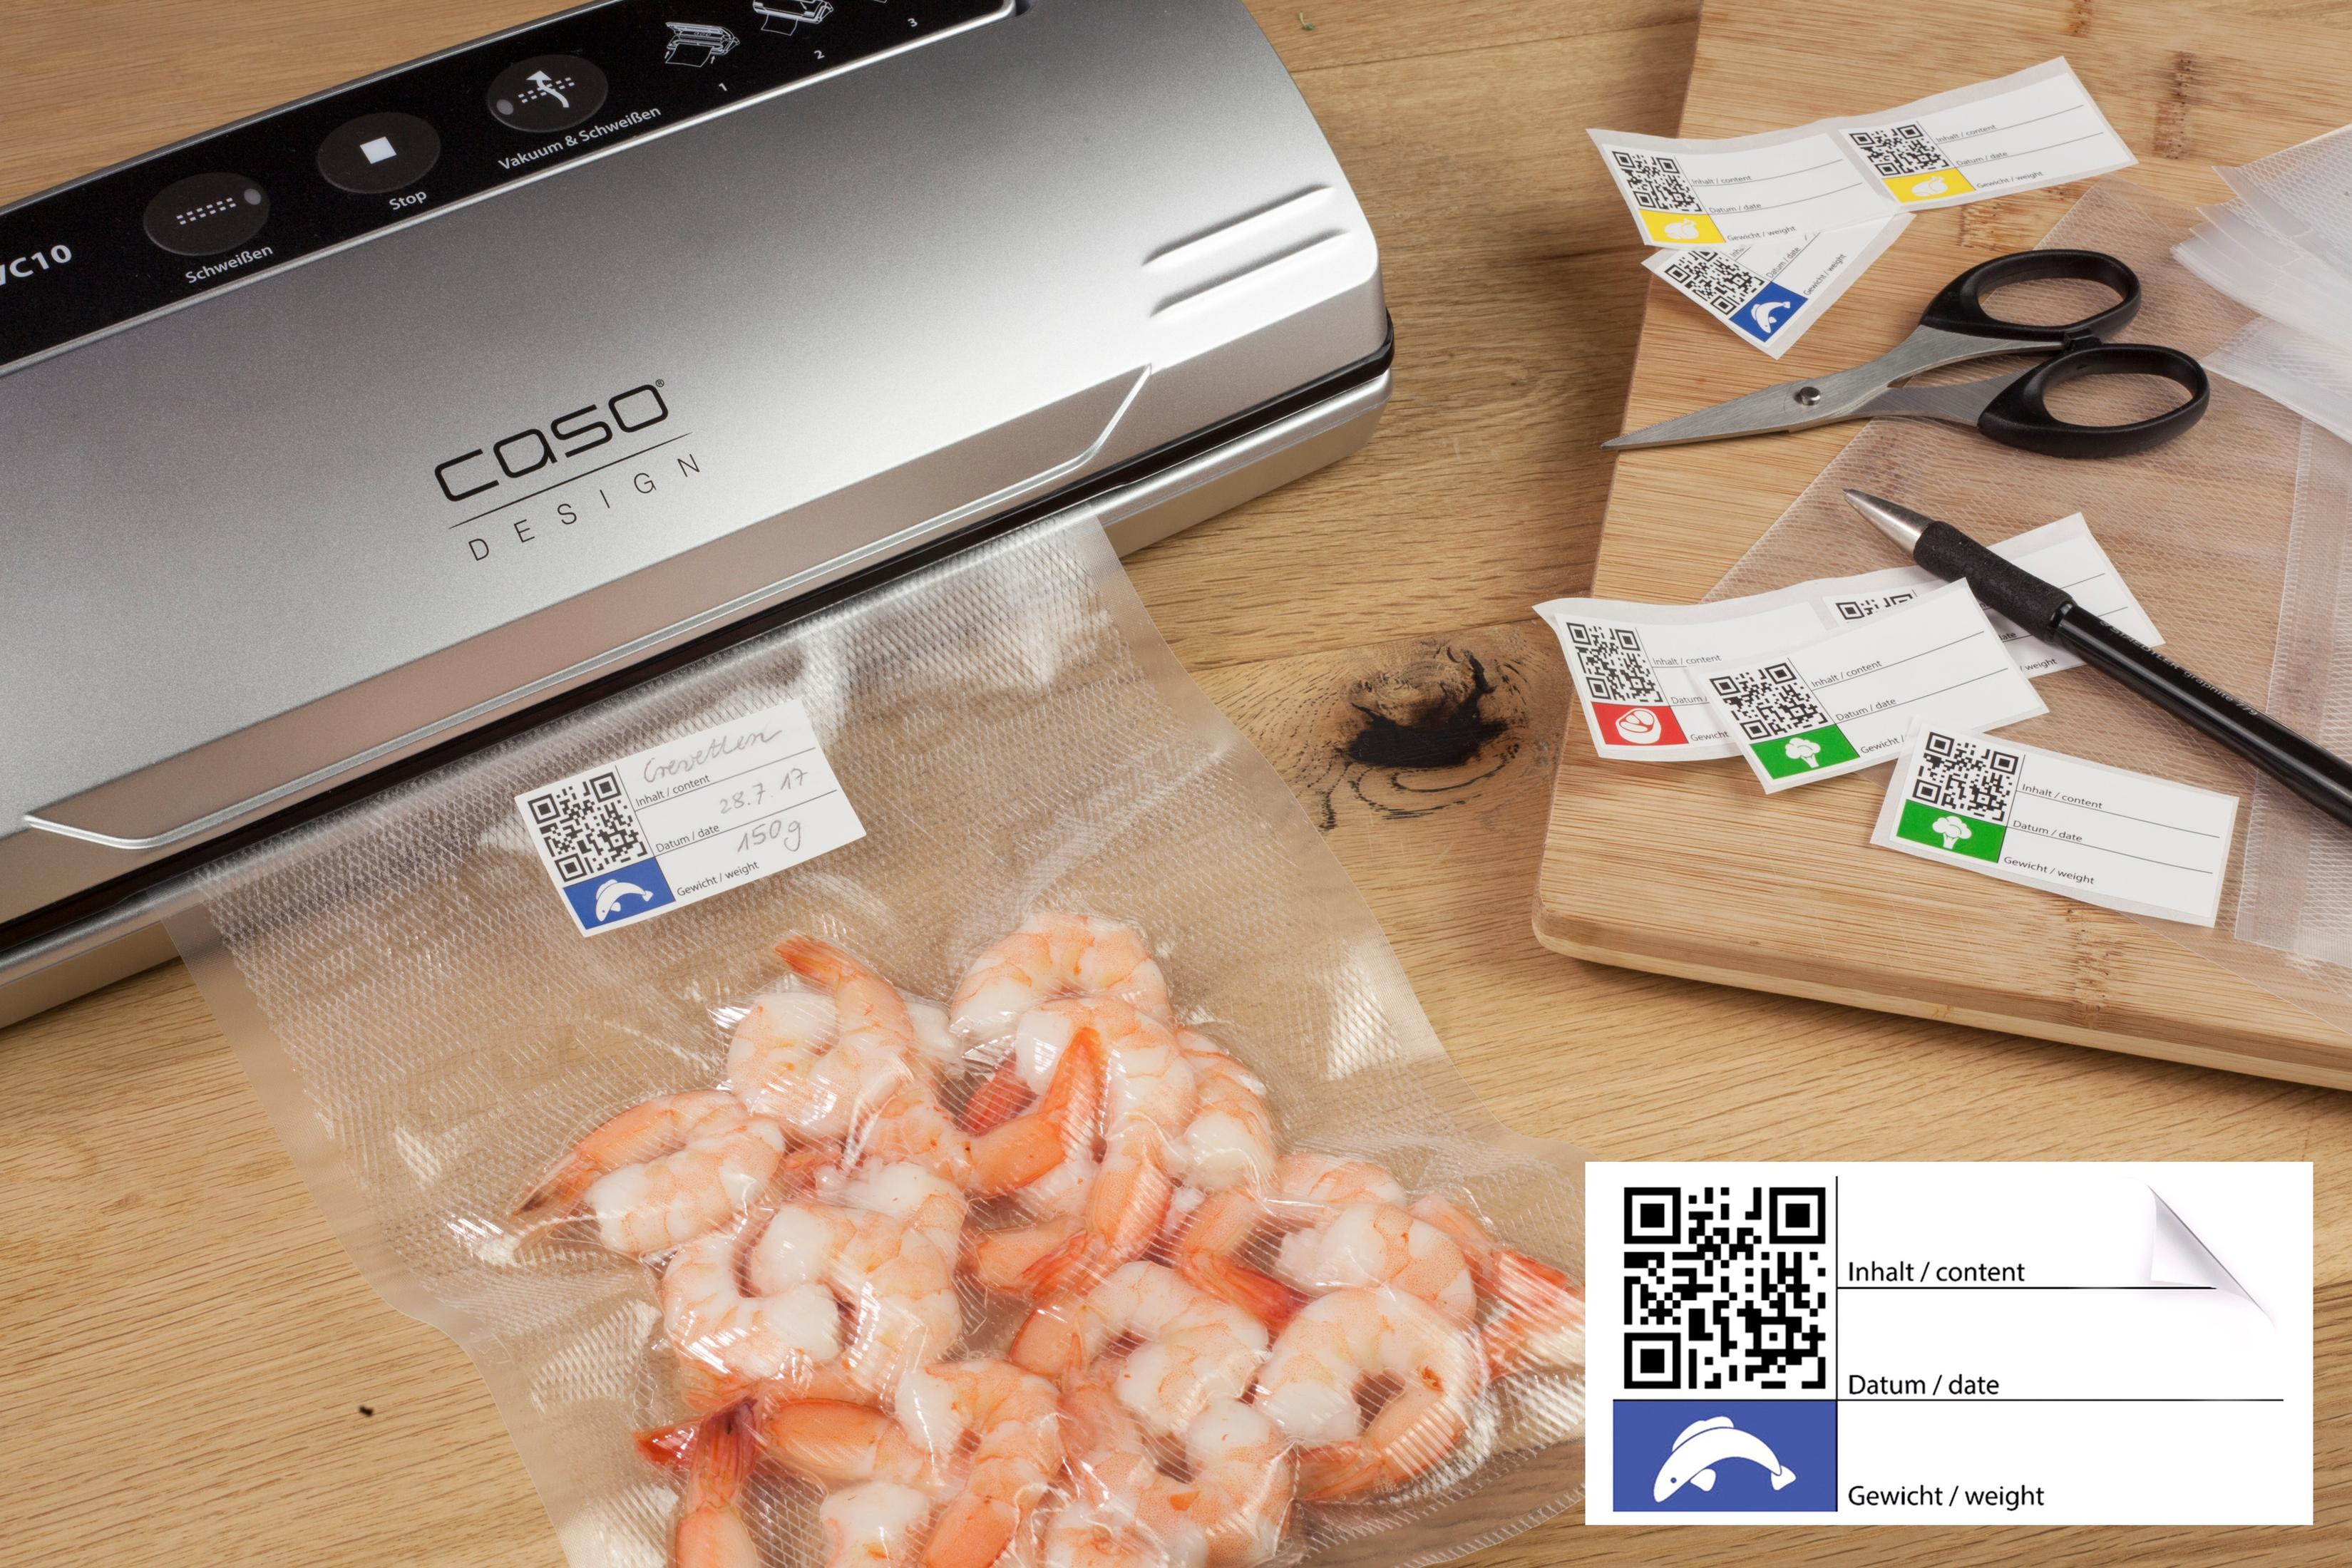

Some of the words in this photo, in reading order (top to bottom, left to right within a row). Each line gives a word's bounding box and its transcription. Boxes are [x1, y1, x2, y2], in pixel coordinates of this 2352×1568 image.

[908, 18, 918, 27] 3
[814, 50, 825, 59] 2
[719, 83, 728, 91] 1
[498, 142, 563, 169] Vakuum
[565, 135, 578, 147] &
[579, 108, 662, 141] Schweißen
[1936, 133, 1960, 143] Inhalt
[1966, 125, 1996, 136] content
[1956, 157, 1983, 166] Datum
[1721, 175, 1752, 184] content
[1976, 177, 2009, 188] Gewicht
[2015, 171, 2044, 180] weight
[389, 190, 427, 210] Stop
[1727, 232, 1760, 241] Gewicht
[1767, 226, 1797, 236] weight
[185, 246, 273, 284] Schweißen
[1766, 261, 1786, 278] Datum
[1787, 247, 1800, 259] date
[1803, 274, 1827, 296] Gewicht
[1828, 253, 1847, 272] weight
[468, 453, 700, 561] DESIGN
[1686, 655, 1722, 665] content
[2025, 659, 2058, 671] weight
[1811, 675, 1839, 688] Inhalt
[1847, 660, 1883, 677] content
[1670, 696, 1703, 704] Datum
[1835, 707, 1869, 721] Datum
[1875, 698, 1896, 709] date
[1690, 731, 1730, 741] Gewicht
[1860, 738, 1899, 753] Gewicht
[635, 790, 664, 807] Inhalt
[672, 775, 711, 793] content
[2022, 783, 2052, 797] Inhalt
[2061, 795, 2102, 809] content
[655, 835, 690, 852] Datum
[697, 824, 719, 837] date
[2013, 820, 2049, 835] Datum
[2058, 831, 2083, 842] date
[677, 876, 719, 897] Gewicht
[724, 861, 760, 879] weight
[2004, 856, 2048, 873] Gewicht
[2058, 870, 2095, 884] weight
